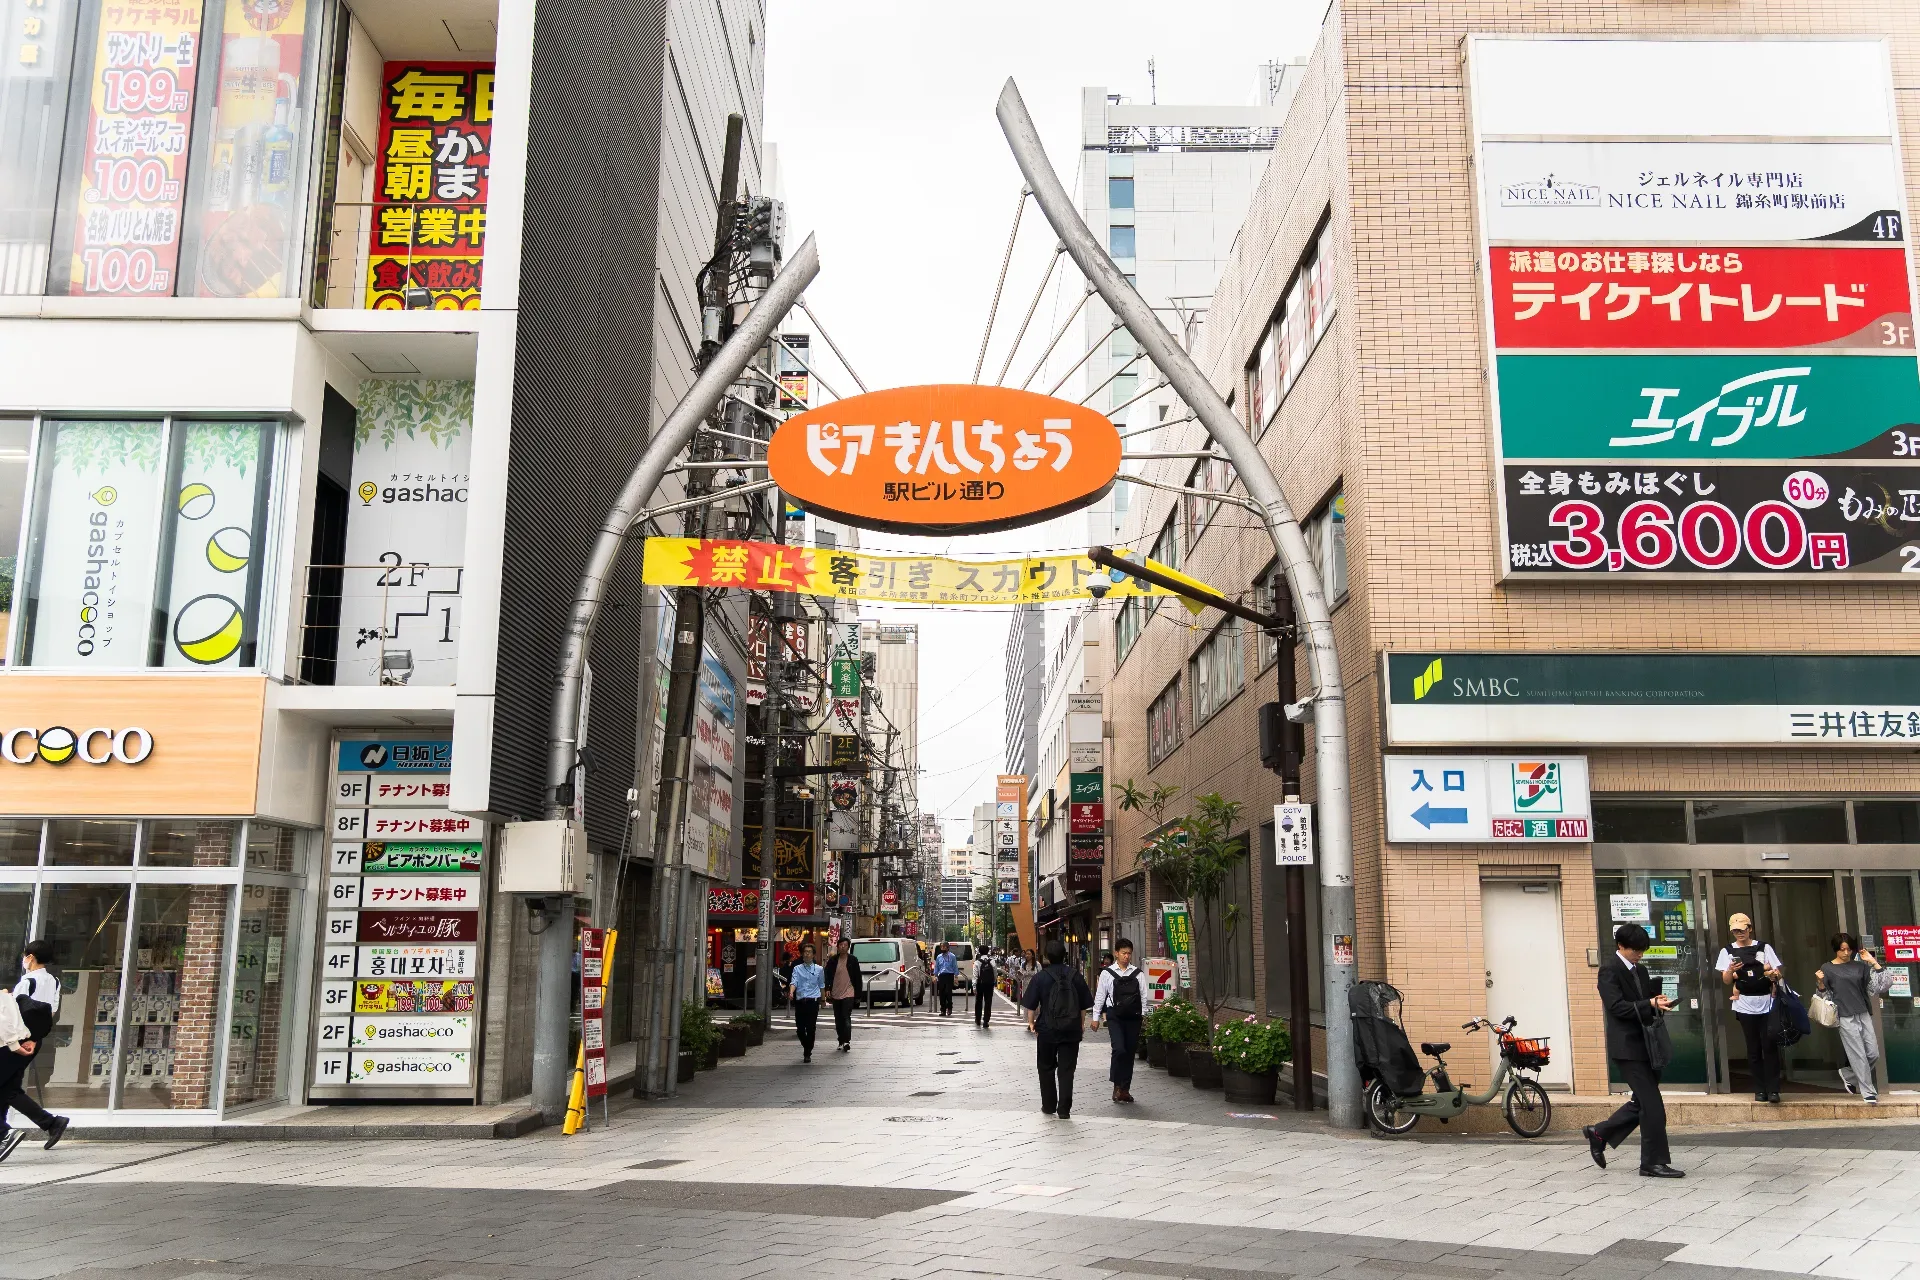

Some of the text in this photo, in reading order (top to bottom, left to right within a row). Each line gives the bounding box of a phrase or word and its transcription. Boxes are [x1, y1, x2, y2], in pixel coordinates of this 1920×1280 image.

[106, 33, 193, 65] サントリー生
[105, 69, 189, 111] 199円
[97, 118, 185, 137] レモンサワー
[387, 128, 491, 164] 昼か
[96, 158, 179, 201] 100円
[384, 163, 489, 200] 朝ま
[1638, 171, 1803, 190] ジェルネイル専門店
[1507, 189, 1595, 200] NICE NAIL
[1608, 192, 1846, 210] NICE NAIL 錦糸町駅前店
[381, 207, 487, 245] 営業中
[1872, 215, 1900, 239] 4F
[85, 248, 169, 291] 100円
[377, 260, 483, 287] 食べ飲み
[1508, 250, 1744, 275] 派遣のお仕事探しなら
[1510, 281, 1869, 322] テイケイトレード
[1880, 321, 1911, 345] 3F
[1608, 366, 1813, 448] エイブル
[805, 418, 1073, 477] ピア きんしちょう
[882, 479, 1006, 502] 駅ビル通り
[1518, 470, 1717, 496] 全身もみほぐし
[1787, 476, 1827, 502] 60分
[1510, 500, 1850, 571] 税込 3,600円
[376, 550, 430, 588] 2F
[710, 545, 1093, 593] 禁止 客引き スカウト
[77, 510, 110, 657] gashacoco
[1452, 677, 1521, 698] SMBC
[1526, 689, 1706, 698] SUMITOMO MITSUI BANKING CORPORATION
[392, 744, 452, 762] 日拓ビ
[340, 782, 363, 798] 9F
[1073, 781, 1102, 795] エイブル
[1410, 768, 1468, 793] 入口
[338, 816, 470, 834] 8F テナント募集中
[1300, 816, 1308, 850] 防犯カメラ
[1493, 820, 1586, 837] たばこ 酒 ATM
[336, 851, 358, 866] 7F
[333, 884, 467, 902] 6F テナント募集中
[331, 919, 352, 935] 5F
[328, 954, 350, 969] 4F
[370, 956, 445, 976] 홍대포차
[325, 989, 348, 1004] 3F
[323, 1025, 454, 1040] 2F gashacoco
[323, 1060, 452, 1075] 1F gashacoco
